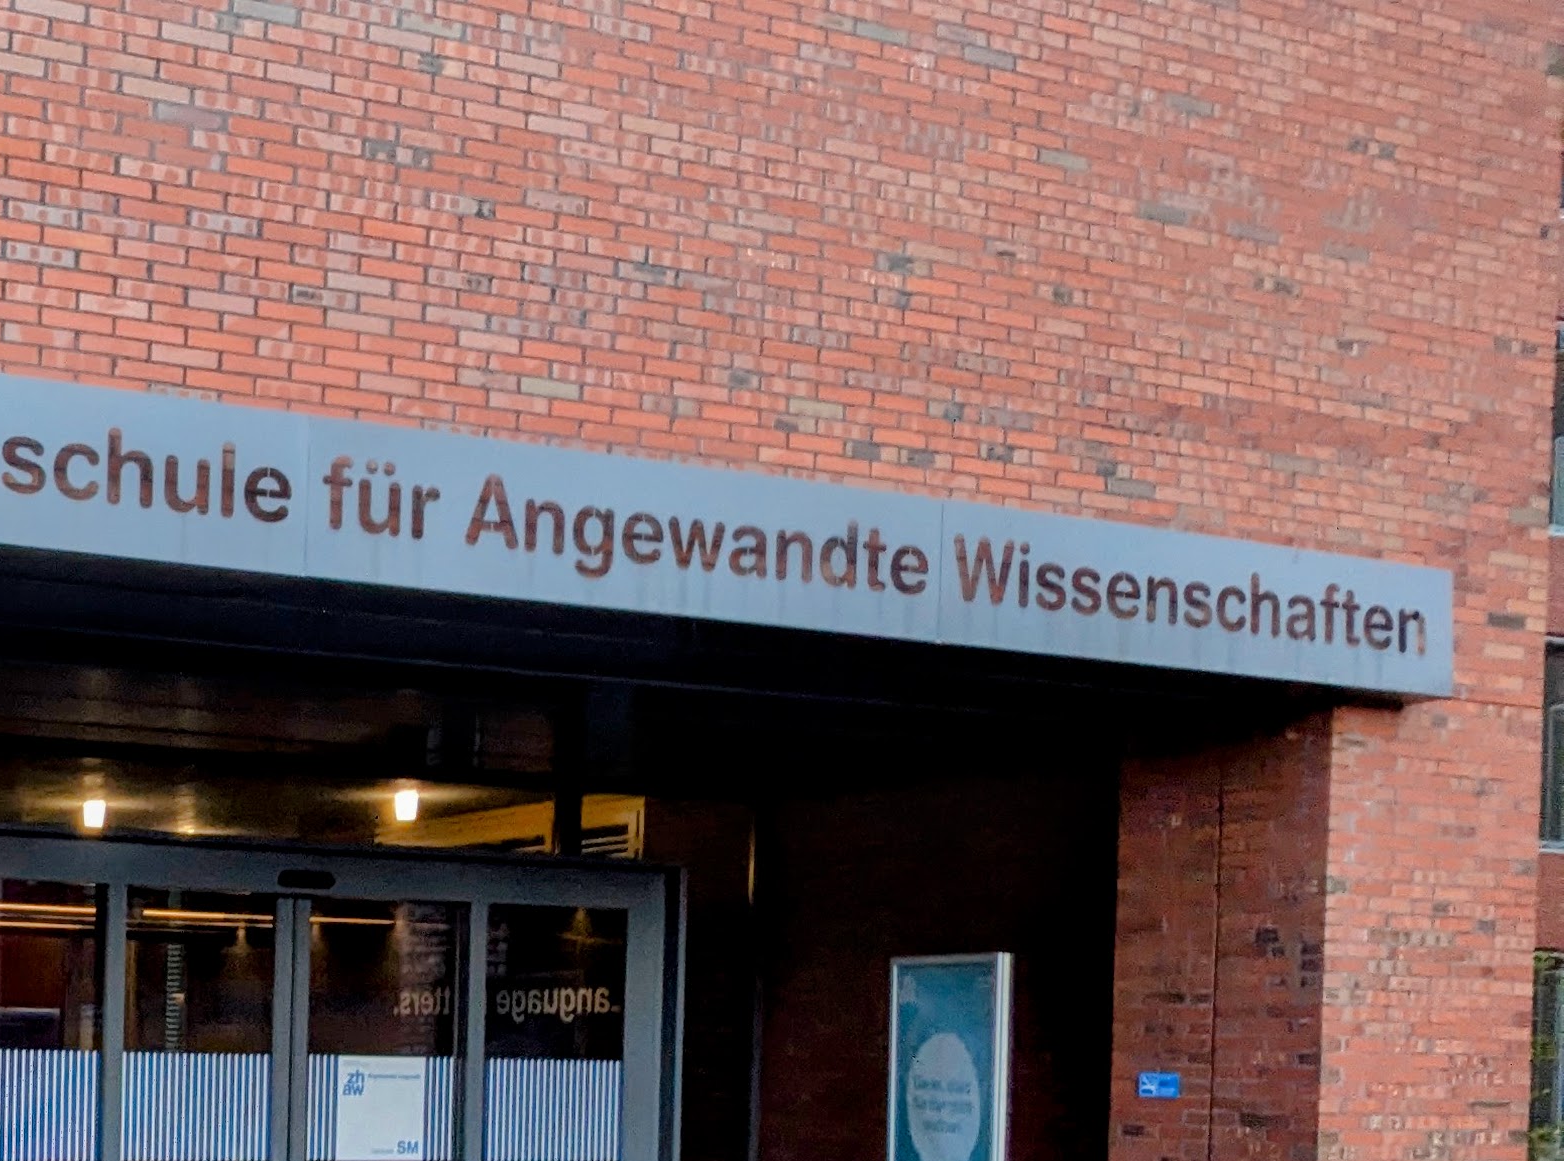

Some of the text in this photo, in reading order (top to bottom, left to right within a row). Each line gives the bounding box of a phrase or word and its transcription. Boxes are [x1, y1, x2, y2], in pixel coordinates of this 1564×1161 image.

[322, 455, 441, 540] für
[464, 473, 930, 595] Angewandte
[952, 532, 1428, 657] Wissenschaften
[397, 1140, 419, 1155] SM
